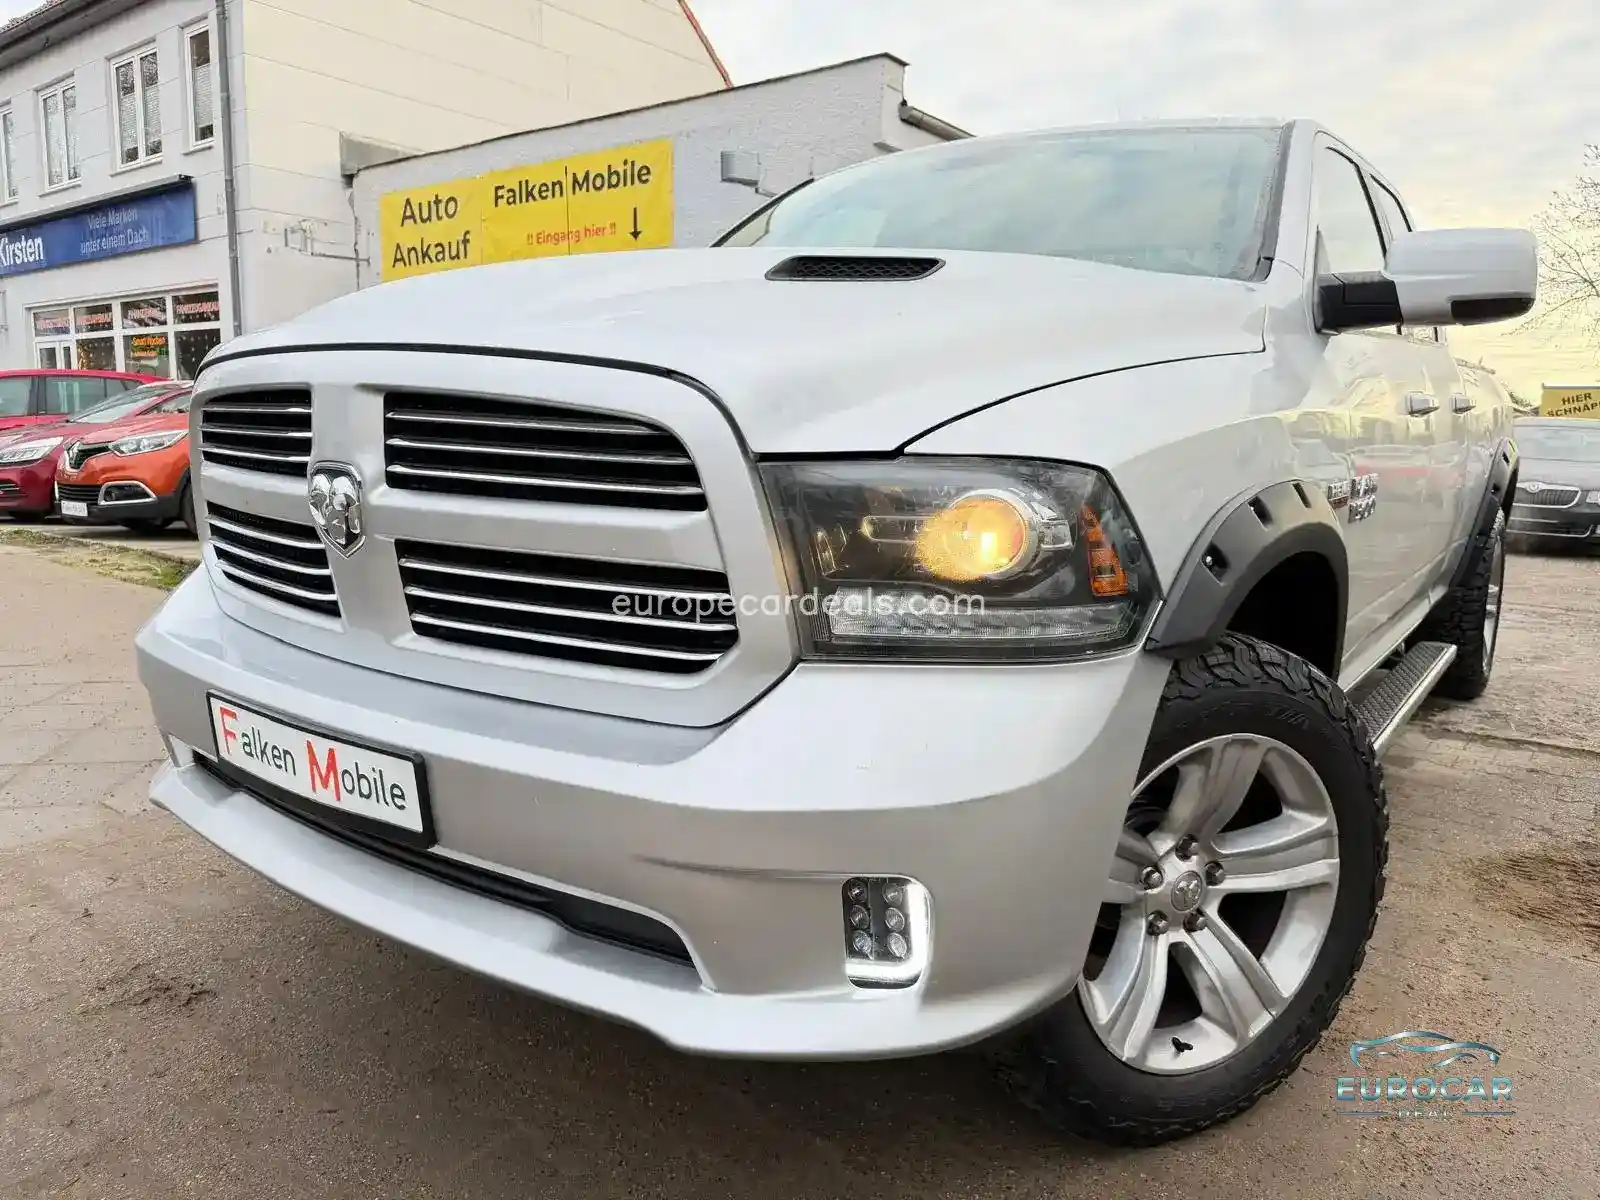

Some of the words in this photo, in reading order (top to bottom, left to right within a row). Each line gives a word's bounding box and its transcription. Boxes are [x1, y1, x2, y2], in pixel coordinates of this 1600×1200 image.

[494, 178, 564, 207] Falken
[571, 159, 652, 195] Mobile
[108, 207, 138, 227] Marken
[400, 194, 459, 226] Auto
[127, 226, 149, 245] Dach
[535, 229, 580, 246] Eingang
[584, 223, 607, 239] hier
[392, 231, 471, 268] Ankauf
[1561, 392, 1593, 406] HIER
[219, 706, 297, 777] Falken
[306, 739, 406, 811] Mobile
